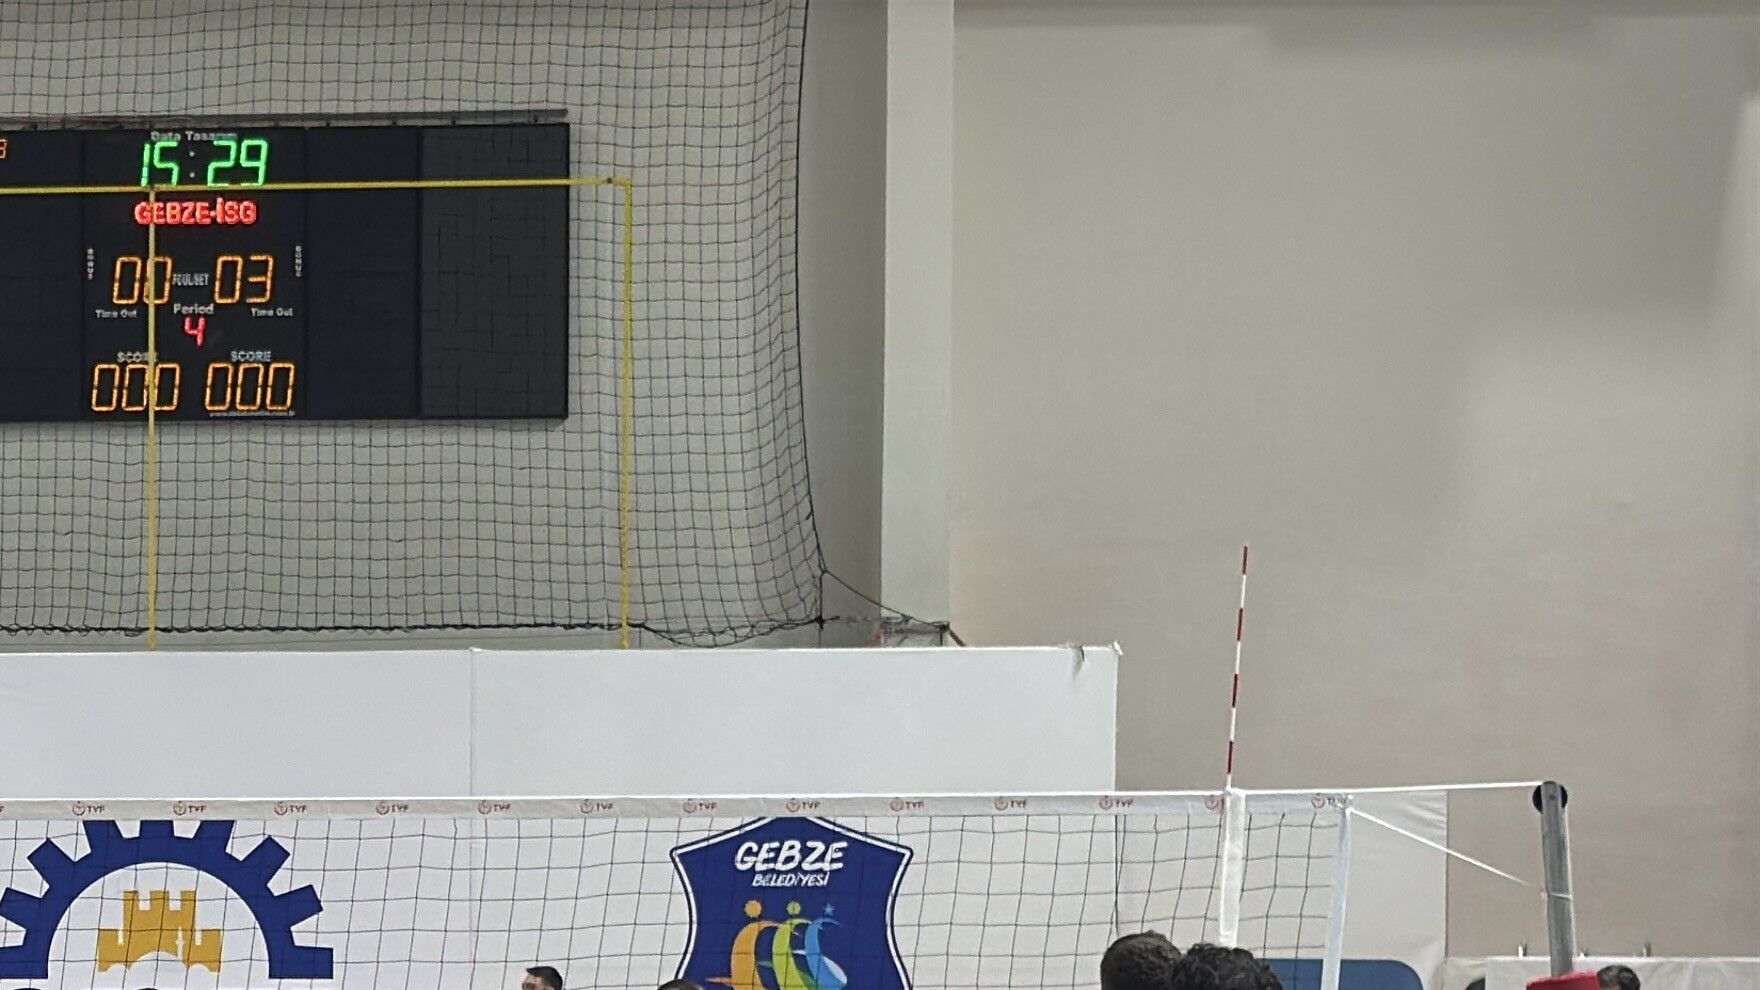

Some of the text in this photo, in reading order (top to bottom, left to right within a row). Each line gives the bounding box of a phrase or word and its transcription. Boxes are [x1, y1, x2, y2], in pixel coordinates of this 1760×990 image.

[141, 139, 268, 187] 15:29
[214, 255, 274, 304] 03
[173, 302, 214, 315] Period
[184, 316, 206, 347] 4
[231, 350, 272, 363] SCORE
[92, 363, 180, 411] 000
[205, 362, 295, 410] 000
[734, 840, 848, 871] GEBZE
[752, 872, 831, 887] BELEDİYESİ
